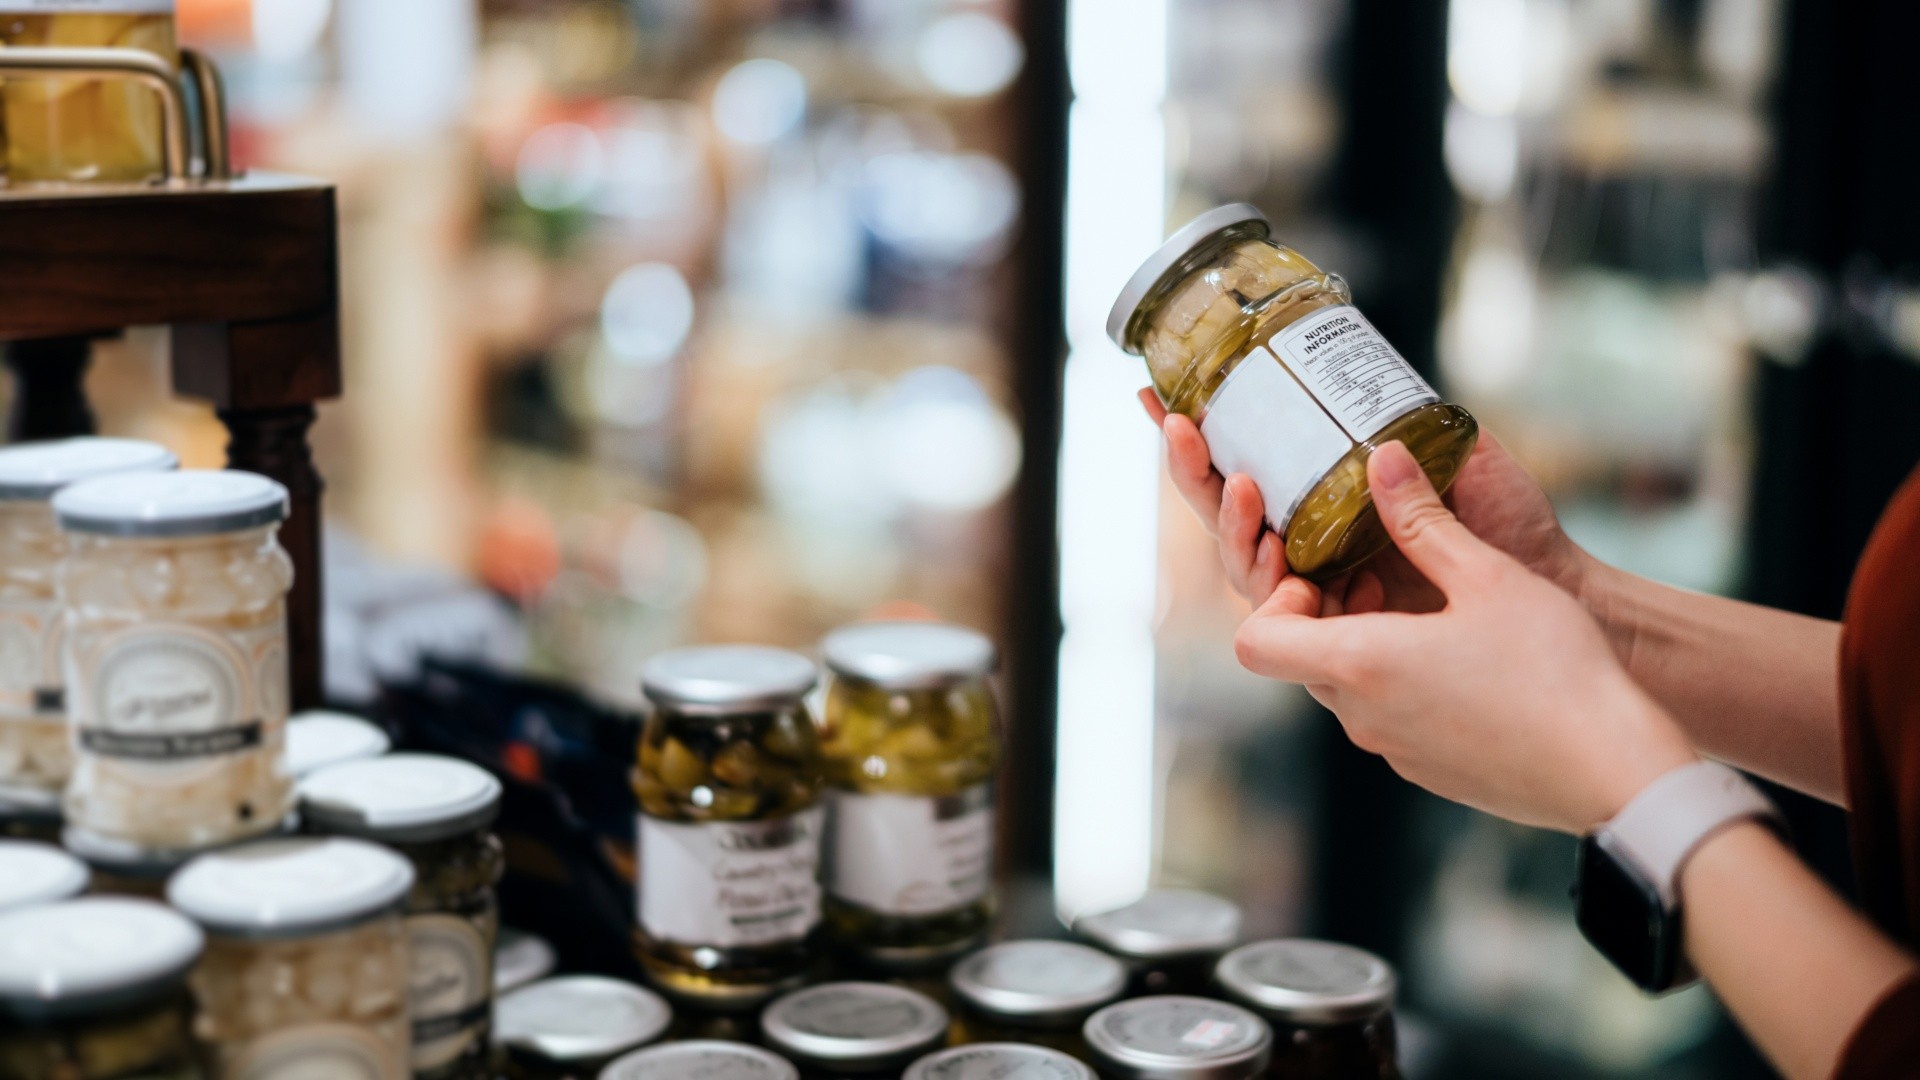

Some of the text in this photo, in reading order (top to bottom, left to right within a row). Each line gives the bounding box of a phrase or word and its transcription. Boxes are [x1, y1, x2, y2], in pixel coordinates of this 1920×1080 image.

[1304, 316, 1350, 342] NUTRITION
[1304, 323, 1361, 354] INFORMATION
[1304, 355, 1319, 367] Mean
[1320, 346, 1334, 357] values
[1324, 348, 1348, 363] Nutrition
